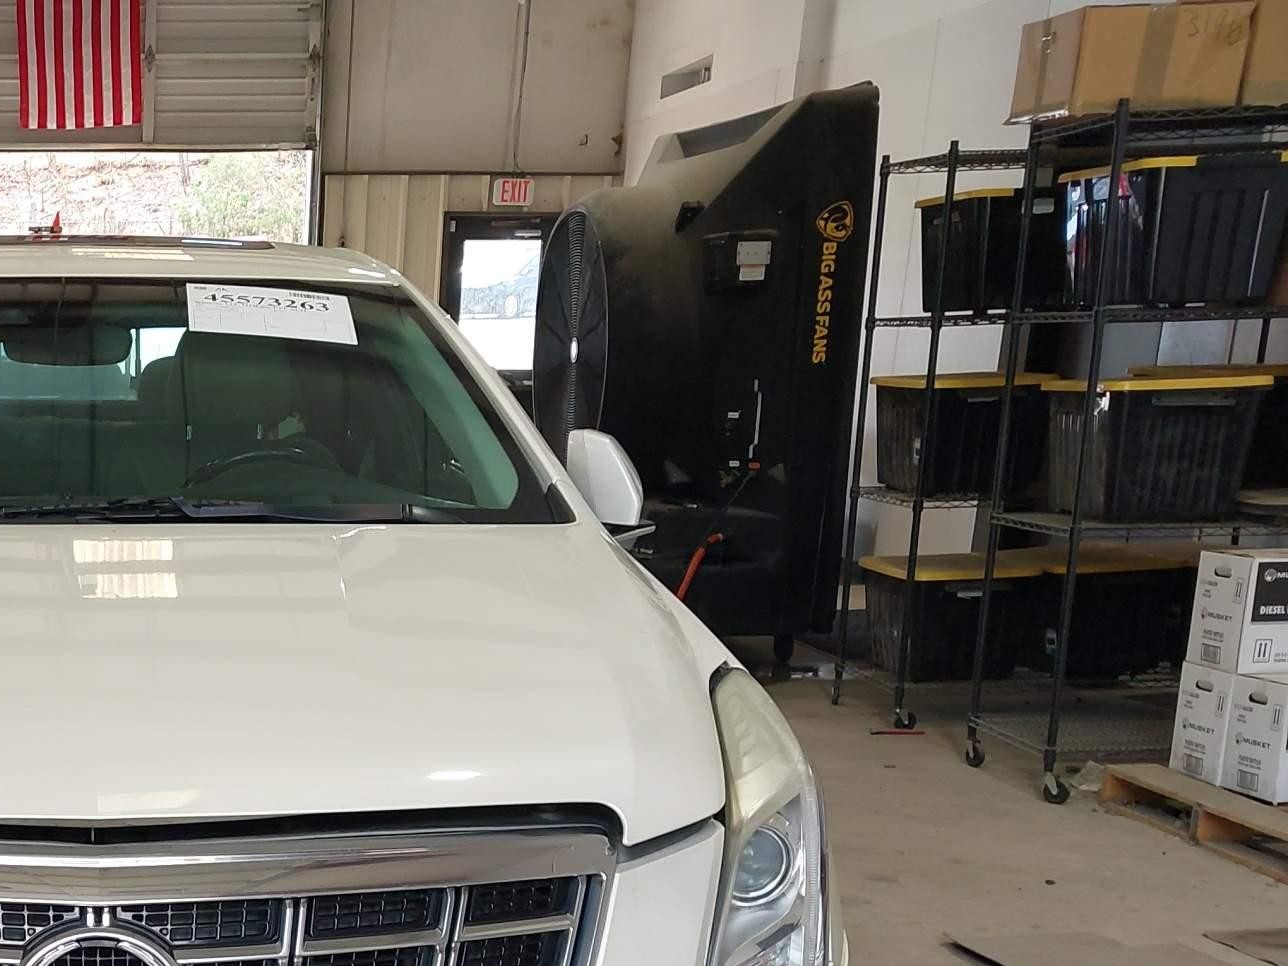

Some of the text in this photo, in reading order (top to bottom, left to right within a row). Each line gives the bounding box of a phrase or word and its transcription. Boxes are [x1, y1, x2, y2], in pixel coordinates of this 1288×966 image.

[500, 180, 530, 203] EXIT
[203, 293, 330, 313] 45573263
[812, 241, 837, 364] BIG ASS FANS
[1259, 605, 1285, 615] DIESEL
[1189, 722, 1215, 734] MUSKET
[1243, 737, 1271, 749] MUSKET
